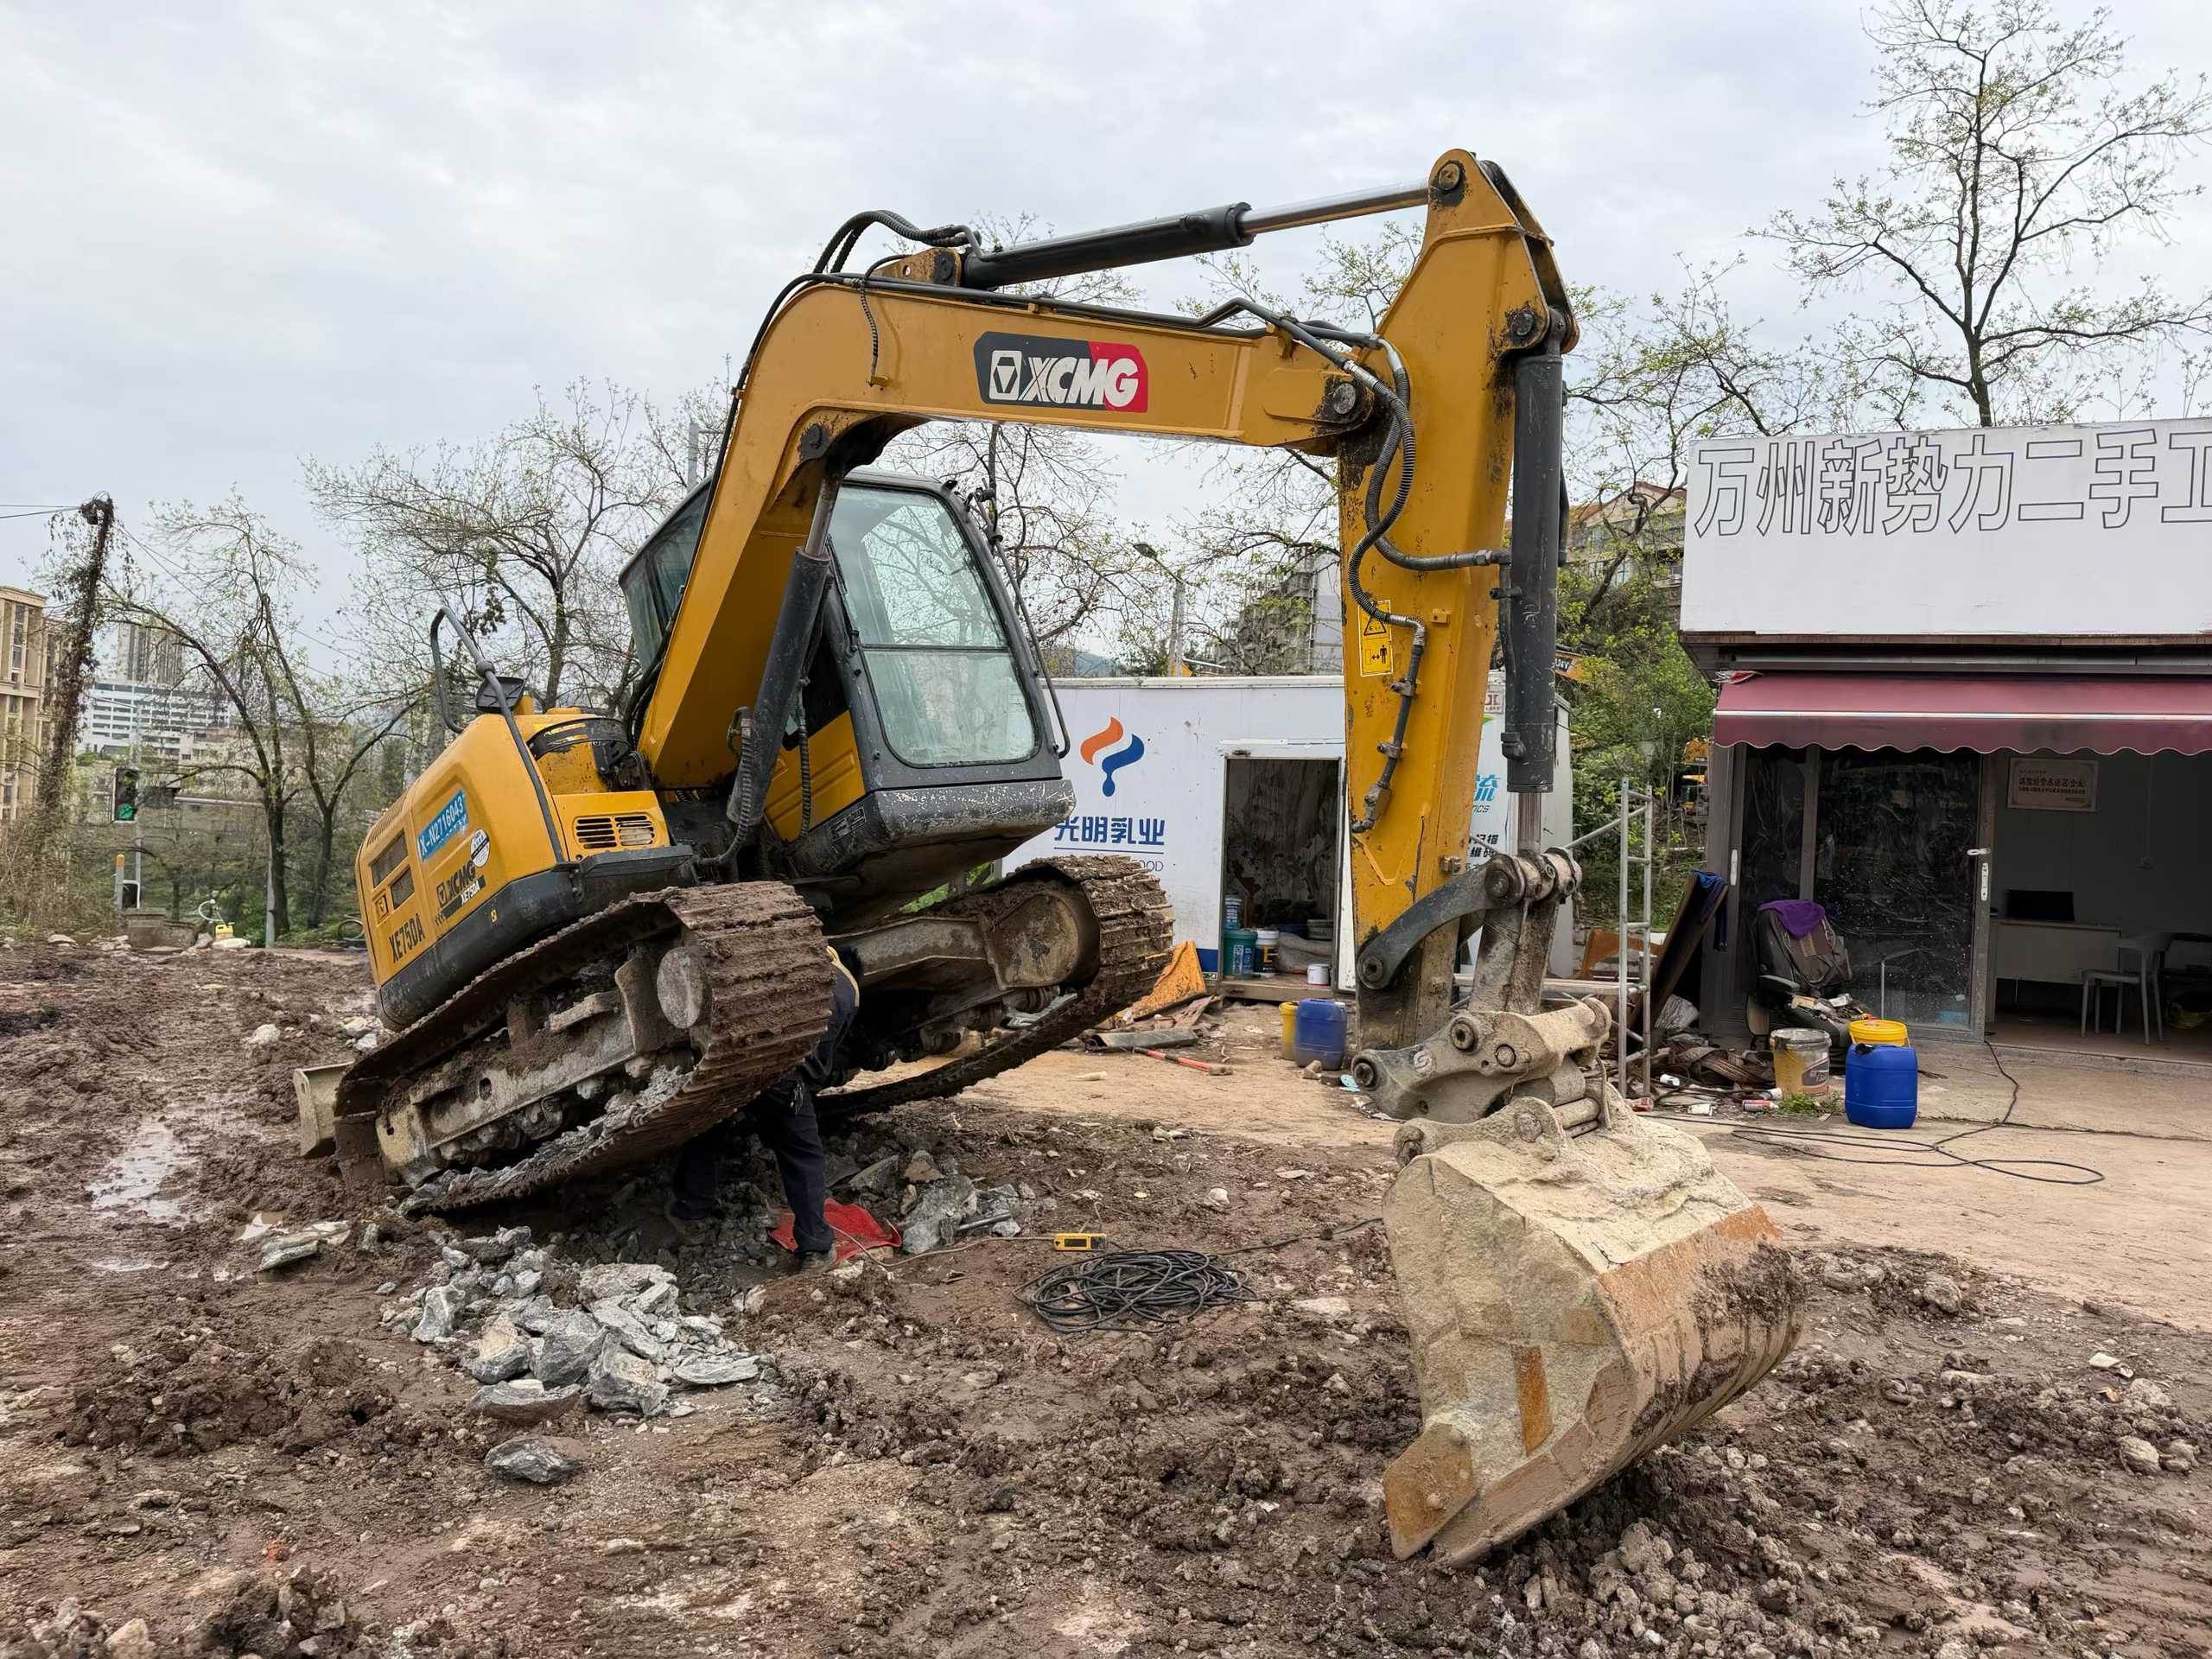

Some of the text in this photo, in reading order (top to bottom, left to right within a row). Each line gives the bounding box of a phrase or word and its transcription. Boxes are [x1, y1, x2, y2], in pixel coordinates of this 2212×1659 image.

[1019, 356, 1140, 408] XCMG
[1694, 429, 2212, 538] 万州新势力二手工
[1054, 816, 1166, 846] 光明乳业
[447, 860, 476, 900] XCMG
[389, 912, 426, 964] XE75DA
